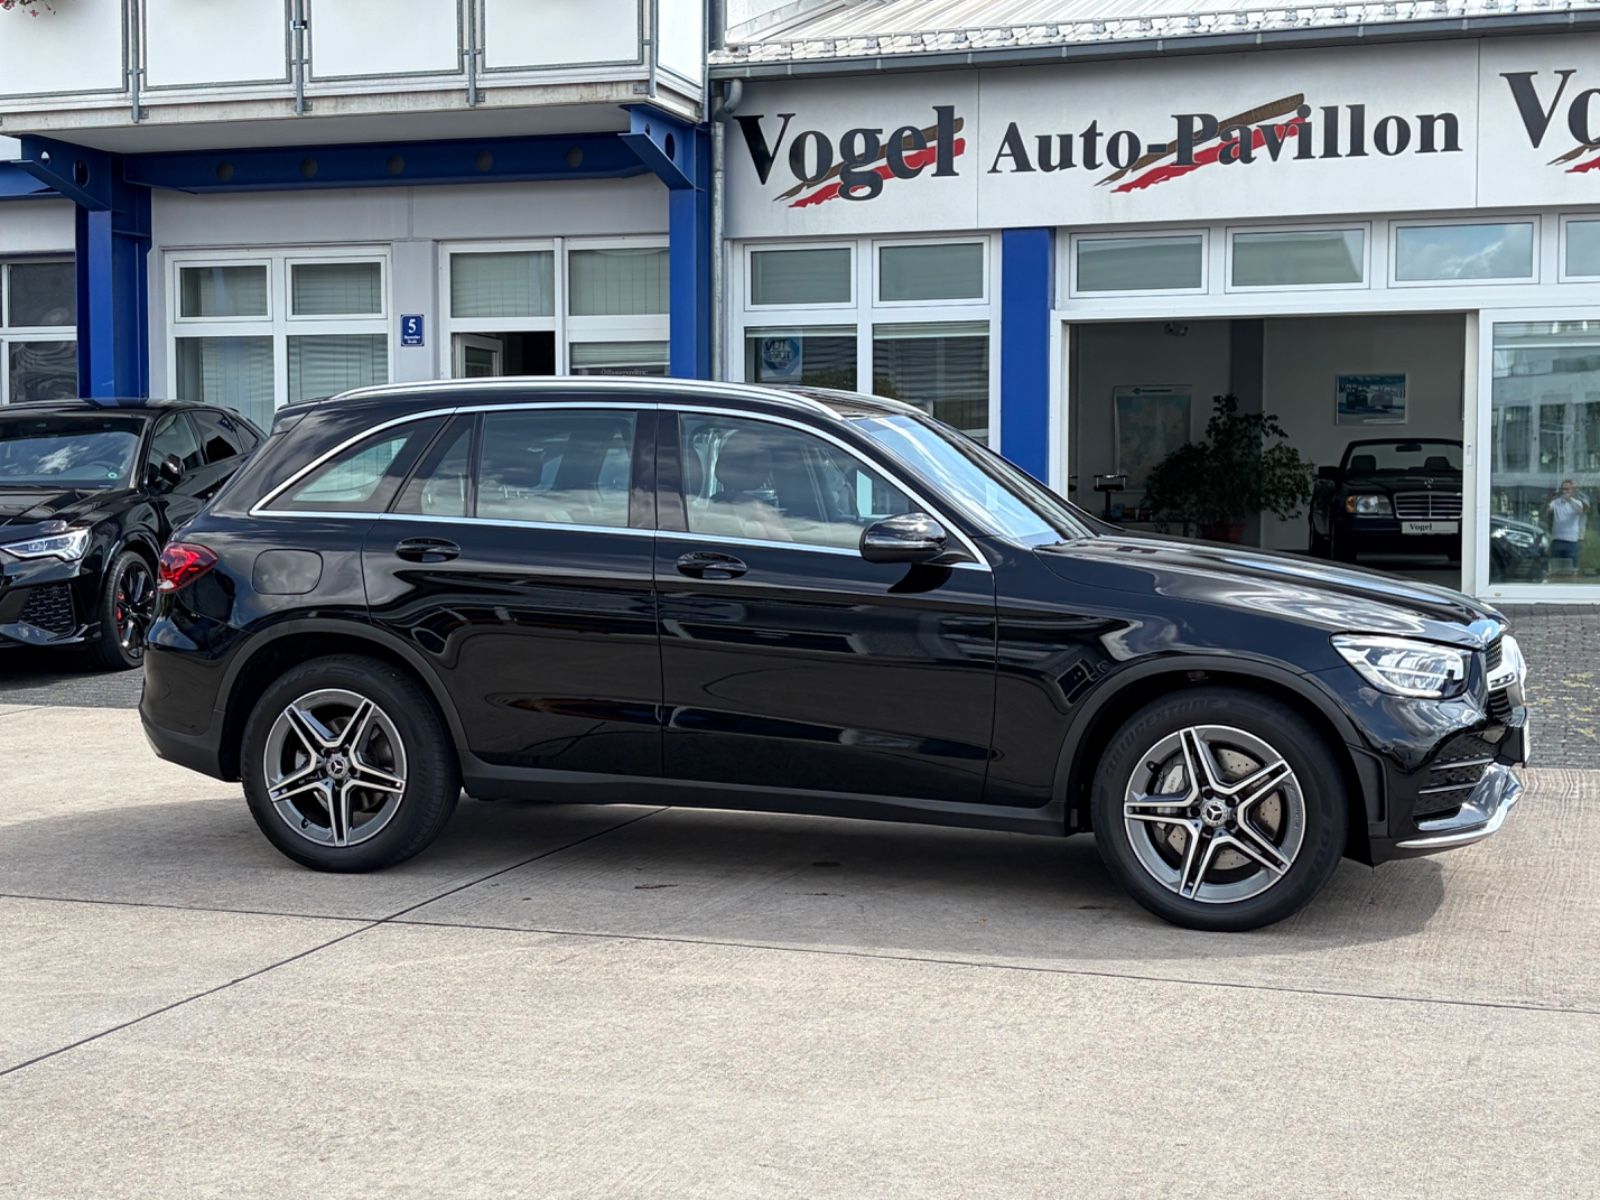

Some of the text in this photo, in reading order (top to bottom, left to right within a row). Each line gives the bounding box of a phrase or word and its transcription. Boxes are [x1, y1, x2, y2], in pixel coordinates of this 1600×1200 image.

[733, 103, 1463, 201] Vogel Auto-Pavillon
[408, 318, 417, 333] 5
[1409, 523, 1433, 531] Vogel
